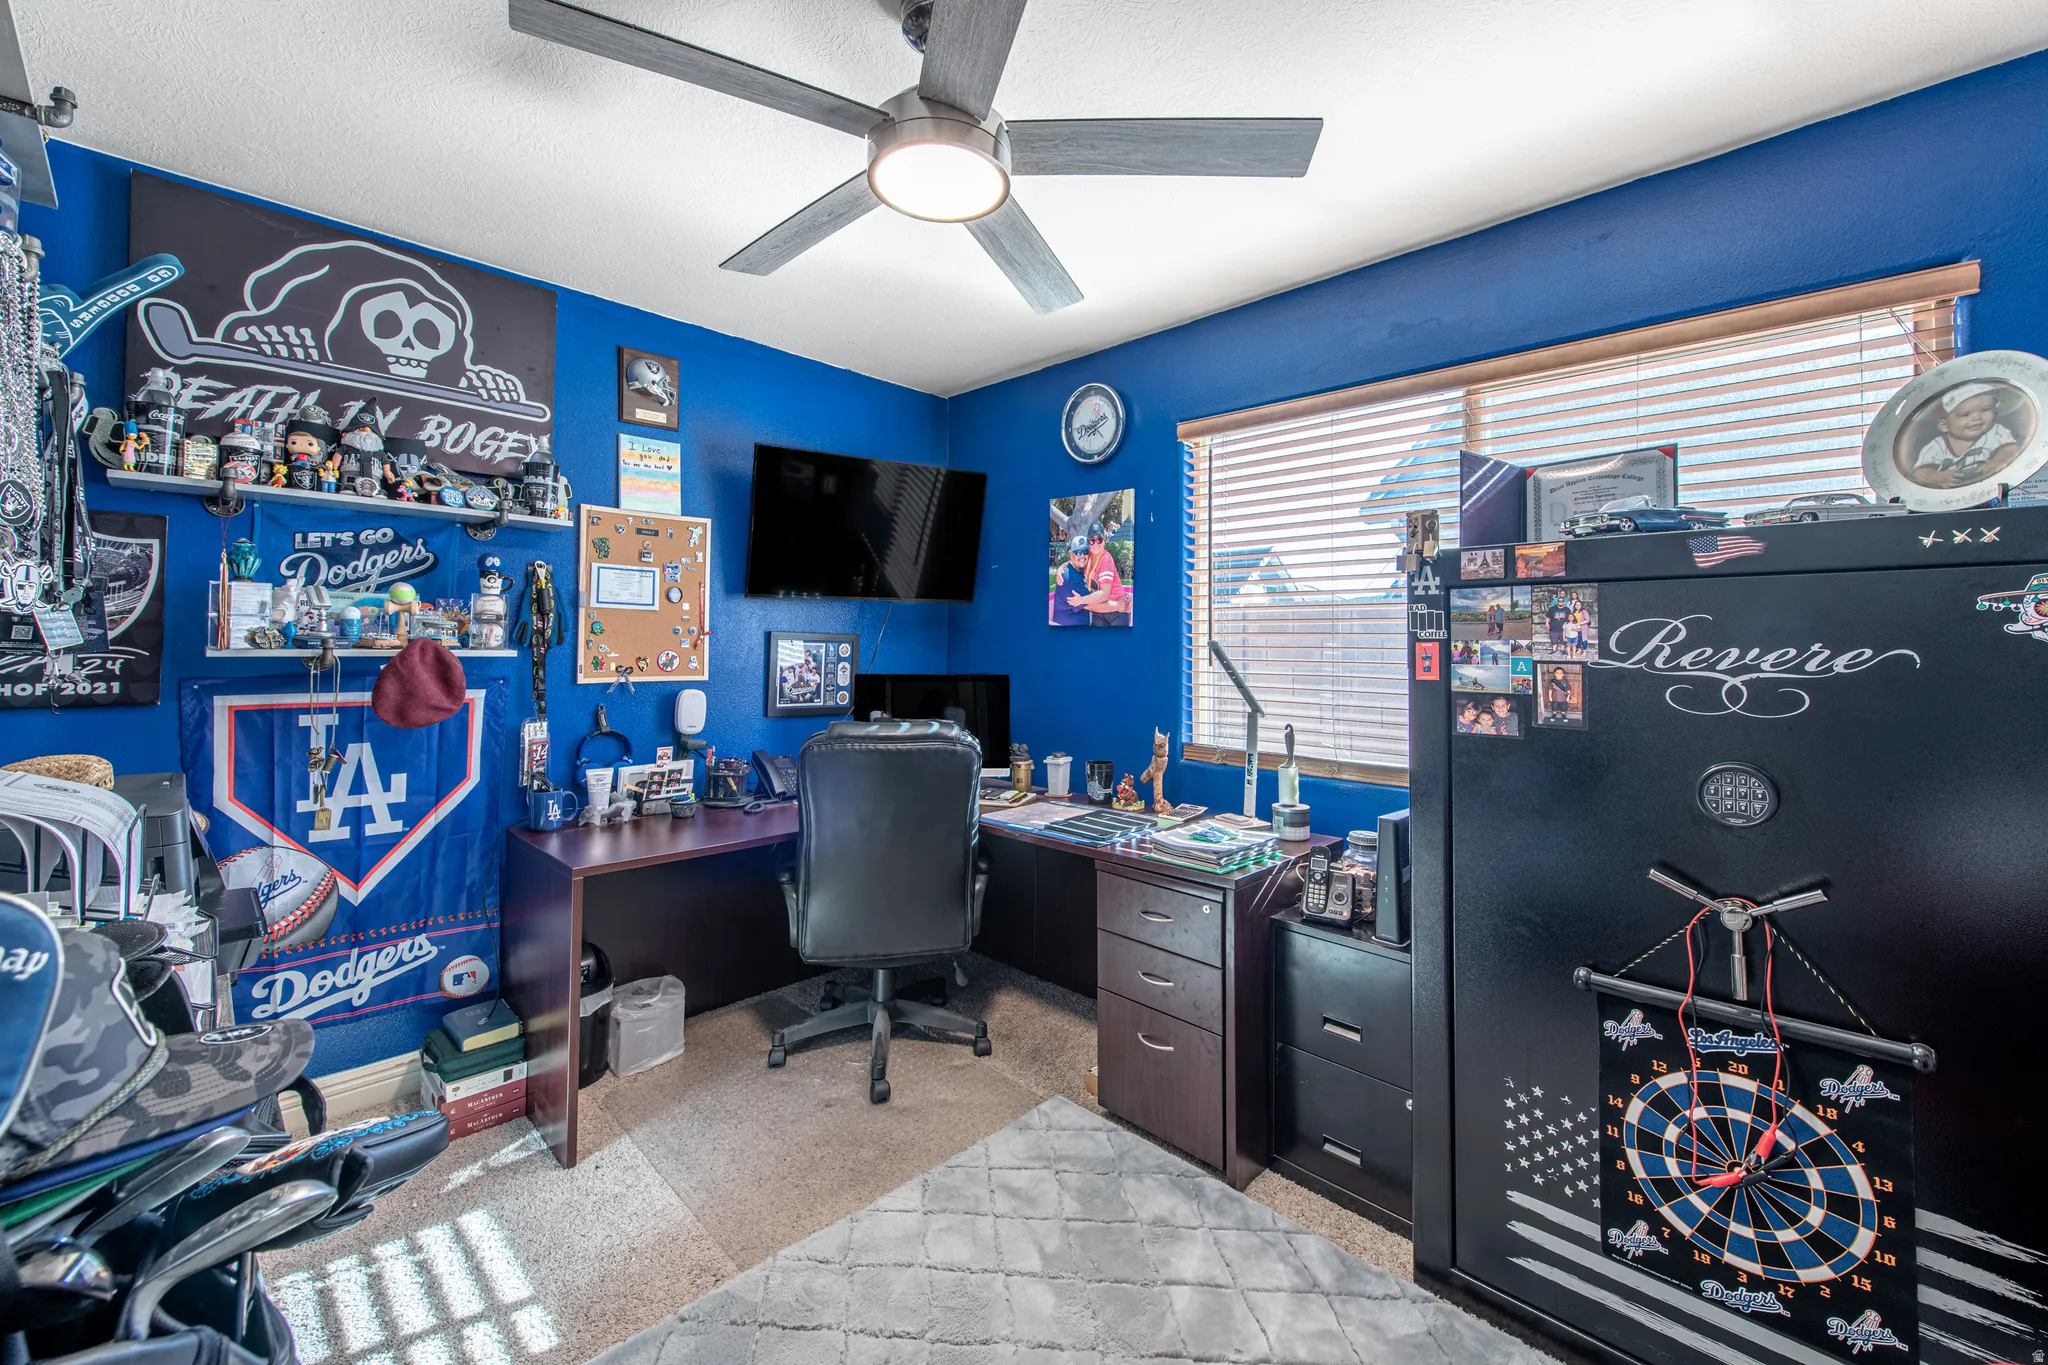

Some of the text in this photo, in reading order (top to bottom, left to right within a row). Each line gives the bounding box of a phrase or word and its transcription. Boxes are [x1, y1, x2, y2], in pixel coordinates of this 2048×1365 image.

[1077, 412, 1109, 440] Dodgers
[415, 415, 549, 468] BOGEY
[642, 444, 661, 454] Love
[640, 453, 670, 463] you dad
[1565, 477, 1587, 487] Applied
[1587, 473, 1621, 482] Technology
[1621, 473, 1644, 482] College
[294, 526, 395, 550] LET'S GO
[280, 537, 435, 594] Dodgers
[1409, 604, 1427, 612] RAD
[1418, 629, 1448, 639] COFFEE
[1590, 613, 1920, 676] Revere
[1516, 661, 1528, 672] A
[60, 681, 120, 696] 2021
[534, 744, 549, 761] 14
[296, 713, 408, 844] LA
[547, 799, 561, 822] LA
[251, 933, 438, 1020] Dodgers
[1604, 1020, 1656, 1040] Dodgers
[1688, 1027, 1717, 1047] Los
[1715, 1029, 1781, 1056] Angeles
[1651, 1059, 1667, 1073] 12
[1727, 1060, 1749, 1075] 20
[1630, 1073, 1641, 1085] 9
[1777, 1079, 1785, 1091] 1
[1819, 1078, 1889, 1102] Dodgers
[1607, 1094, 1624, 1109] 14
[1816, 1104, 1838, 1120] 18
[1606, 1124, 1620, 1138] 11
[1852, 1140, 1866, 1153] 4
[1616, 1159, 1626, 1171] 8
[1873, 1176, 1893, 1192] 13
[1626, 1190, 1644, 1205] 16
[1883, 1215, 1896, 1229] 6
[1607, 1228, 1662, 1252] Dodgers
[1661, 1226, 1672, 1239] 7
[1692, 1249, 1712, 1265] 19
[1874, 1249, 1896, 1267] 10
[1736, 1271, 1748, 1284] 3
[1851, 1274, 1872, 1292] 15
[1700, 1279, 1784, 1313] Dodgers
[1777, 1283, 1796, 1299] 17
[1819, 1284, 1832, 1298] 2
[1826, 1316, 1898, 1346] Dodgers
